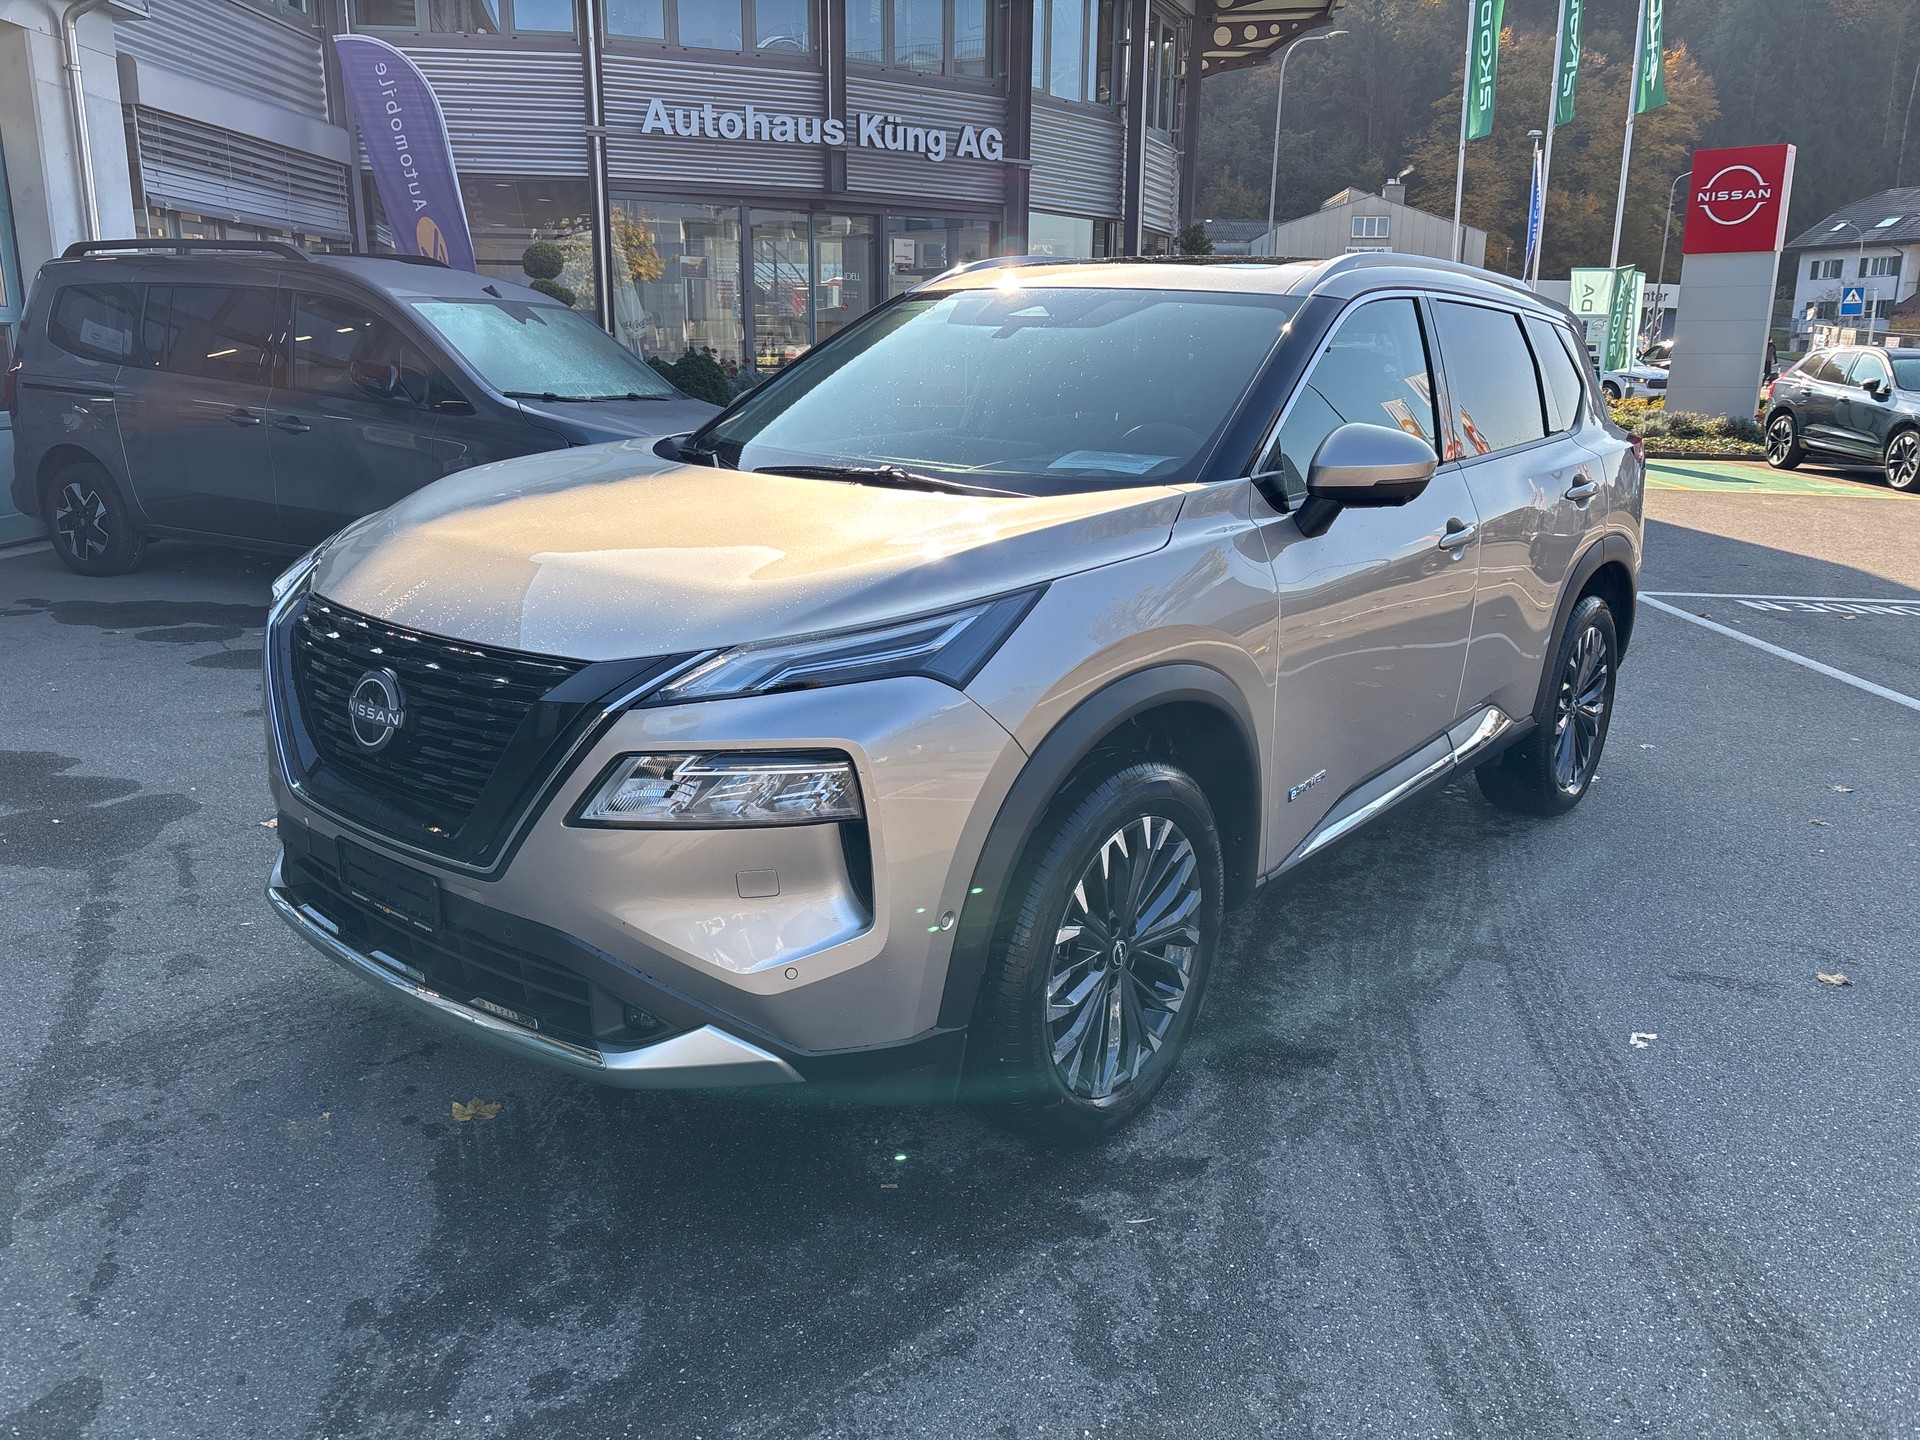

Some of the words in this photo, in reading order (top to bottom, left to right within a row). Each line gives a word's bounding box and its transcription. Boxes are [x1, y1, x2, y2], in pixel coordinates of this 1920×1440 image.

[641, 98, 845, 145] Autohaus
[857, 113, 947, 161] Küng
[957, 125, 1003, 161] AG
[1697, 188, 1771, 203] NISSAN
[348, 698, 399, 726] NISSAN
